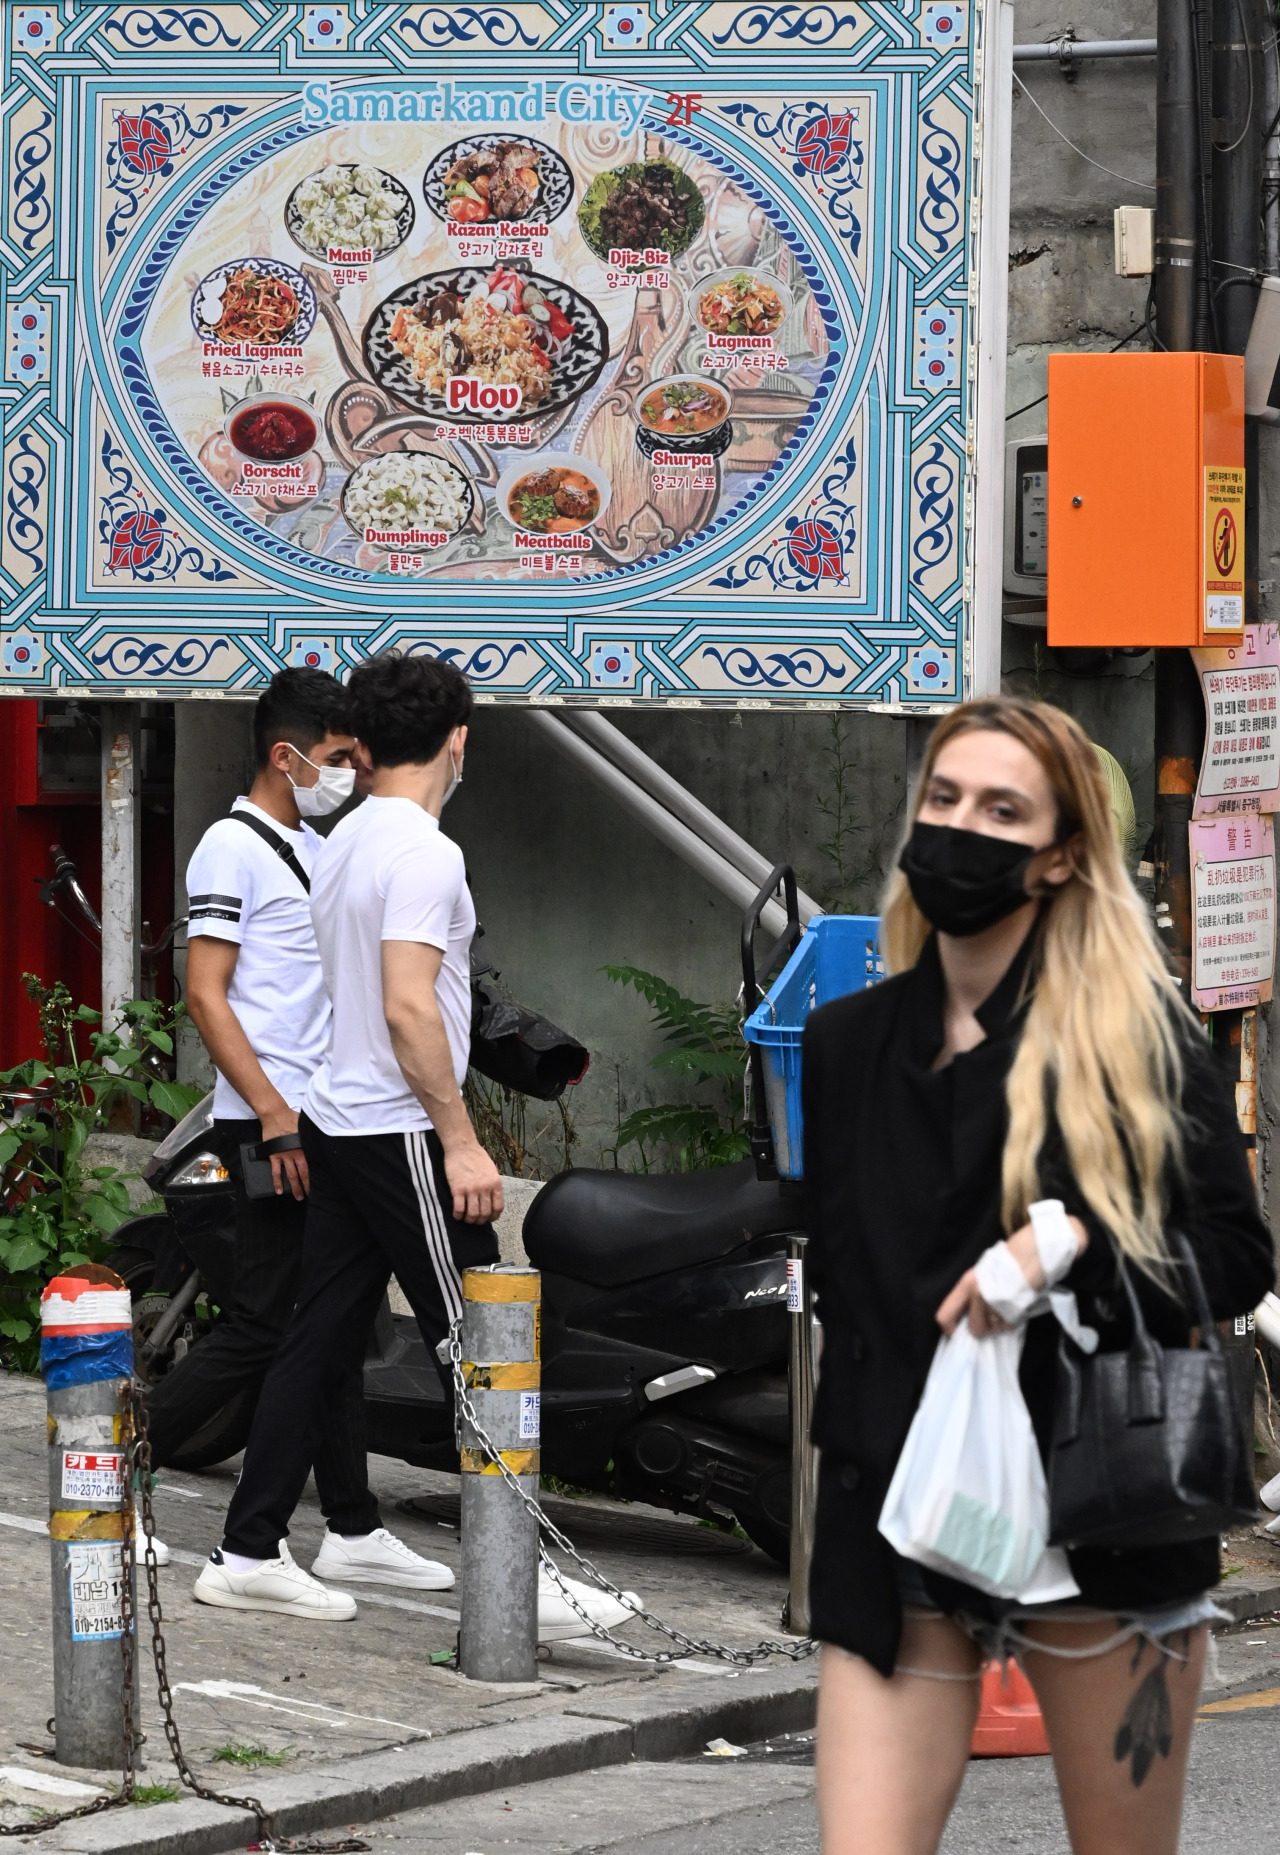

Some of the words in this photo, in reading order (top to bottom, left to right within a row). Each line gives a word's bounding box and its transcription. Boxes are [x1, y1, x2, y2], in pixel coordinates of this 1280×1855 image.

[305, 82, 546, 122] Samarkand
[559, 82, 649, 137] City
[666, 94, 702, 125] 2F
[447, 222, 496, 237] Kazan
[500, 222, 549, 237] Kebab
[328, 248, 372, 262] Manti
[458, 242, 494, 257] 양고기
[497, 241, 543, 257] 감자조림
[610, 250, 669, 268] Djiz-Biz
[333, 269, 368, 285] 찜만두
[606, 273, 642, 288] 양고기
[646, 273, 669, 288] 튀김
[708, 334, 772, 351] Lagman
[203, 343, 241, 357] Fried
[245, 343, 303, 360] lagman
[202, 361, 256, 378] 볶음소고기
[260, 361, 304, 378] 수타국수
[703, 356, 738, 368] 소고기
[742, 354, 788, 370] 수타국수
[450, 379, 518, 409] Plov
[436, 426, 472, 441] 우즈벡
[475, 425, 532, 442] 전통볶음밥
[653, 451, 712, 469] Shurpa
[244, 463, 302, 477] Borscht
[232, 484, 266, 496] 소고기
[269, 483, 317, 496] 야채스프
[653, 474, 689, 490] 양고기
[692, 476, 715, 488] 스프
[365, 529, 448, 547] Dumplings
[515, 535, 591, 549] Meatballs
[390, 554, 423, 570] 물만두
[522, 555, 554, 571] 미트볼
[558, 556, 581, 569] 스프
[1227, 825, 1252, 851] 警告
[68, 1455, 114, 1470] 카드
